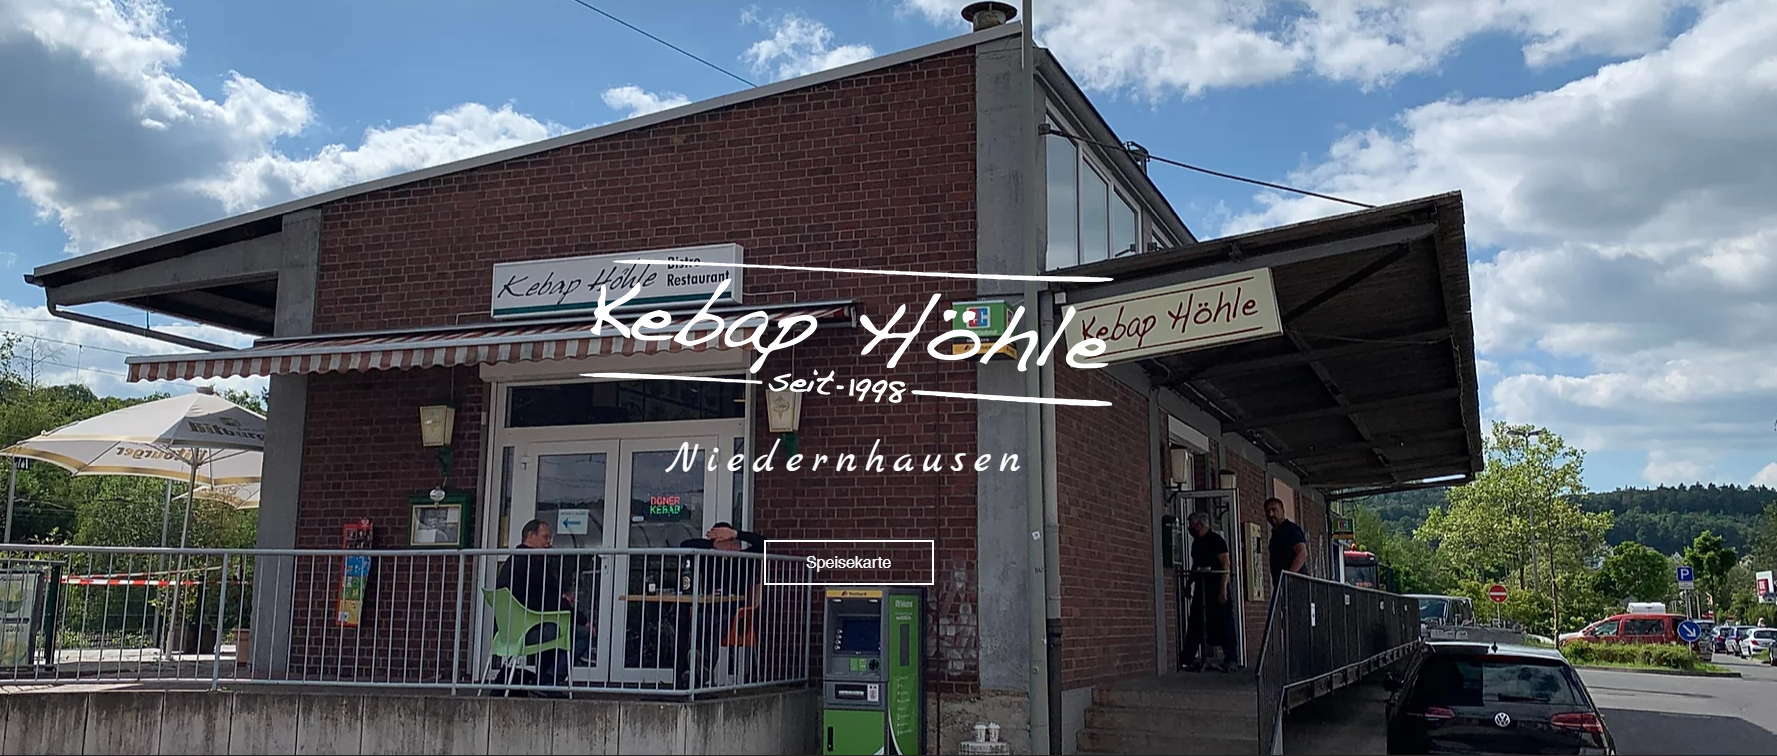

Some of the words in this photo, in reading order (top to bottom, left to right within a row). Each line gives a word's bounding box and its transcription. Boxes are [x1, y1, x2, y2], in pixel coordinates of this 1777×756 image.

[497, 271, 582, 305] Kebap
[588, 258, 657, 292] Höhle
[667, 270, 730, 287] Restaurant
[1082, 306, 1157, 348] Kebap
[1168, 287, 1259, 333] Höhle
[187, 421, 265, 440] Bitburg
[1681, 568, 1690, 580] P
